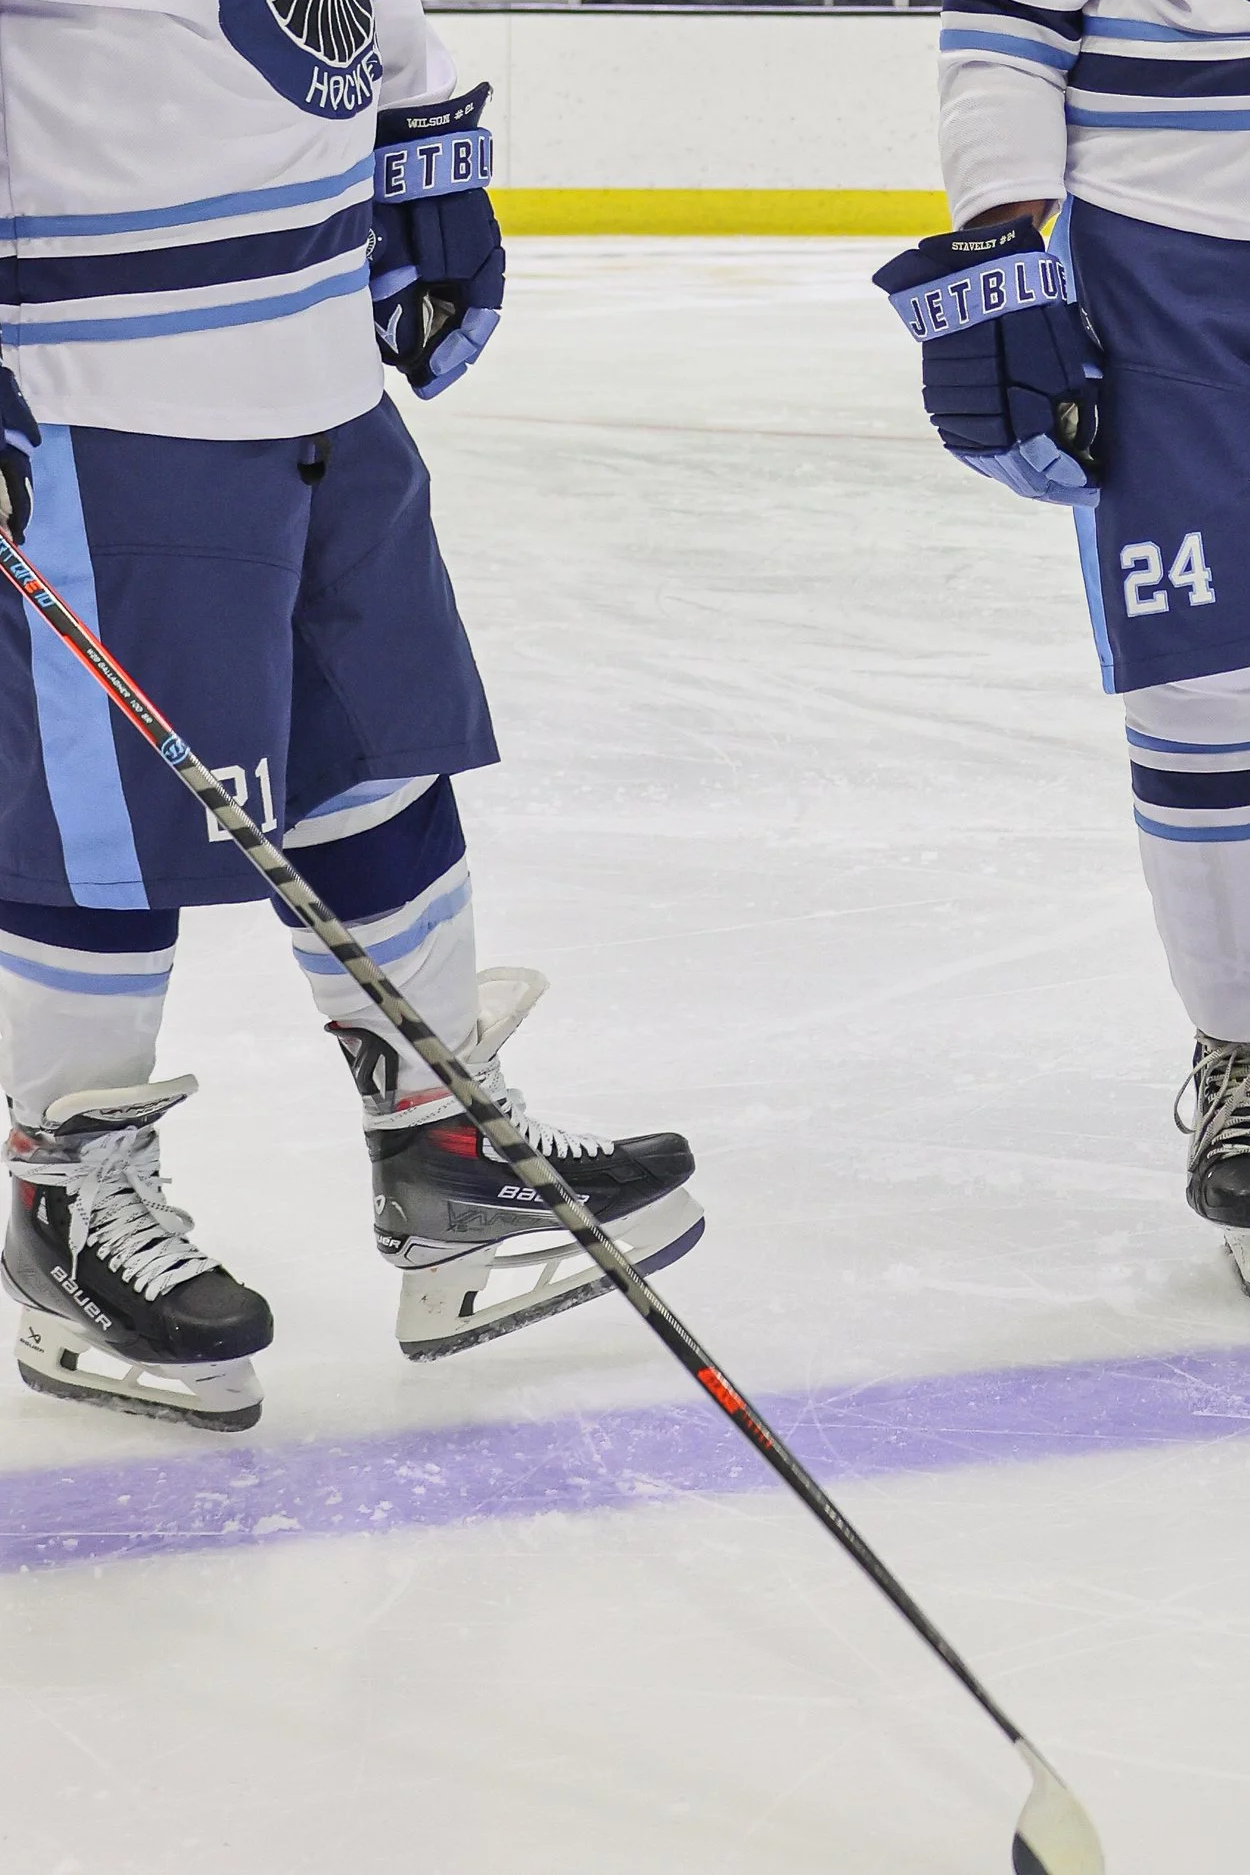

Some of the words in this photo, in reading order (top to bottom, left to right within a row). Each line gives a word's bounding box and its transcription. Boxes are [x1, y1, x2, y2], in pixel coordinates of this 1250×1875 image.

[306, 45, 381, 111] HOCKE
[406, 113, 451, 128] WILSON
[952, 238, 997, 251] STAVELEY
[910, 258, 1067, 338] JETBLUE
[1120, 531, 1216, 617] 24
